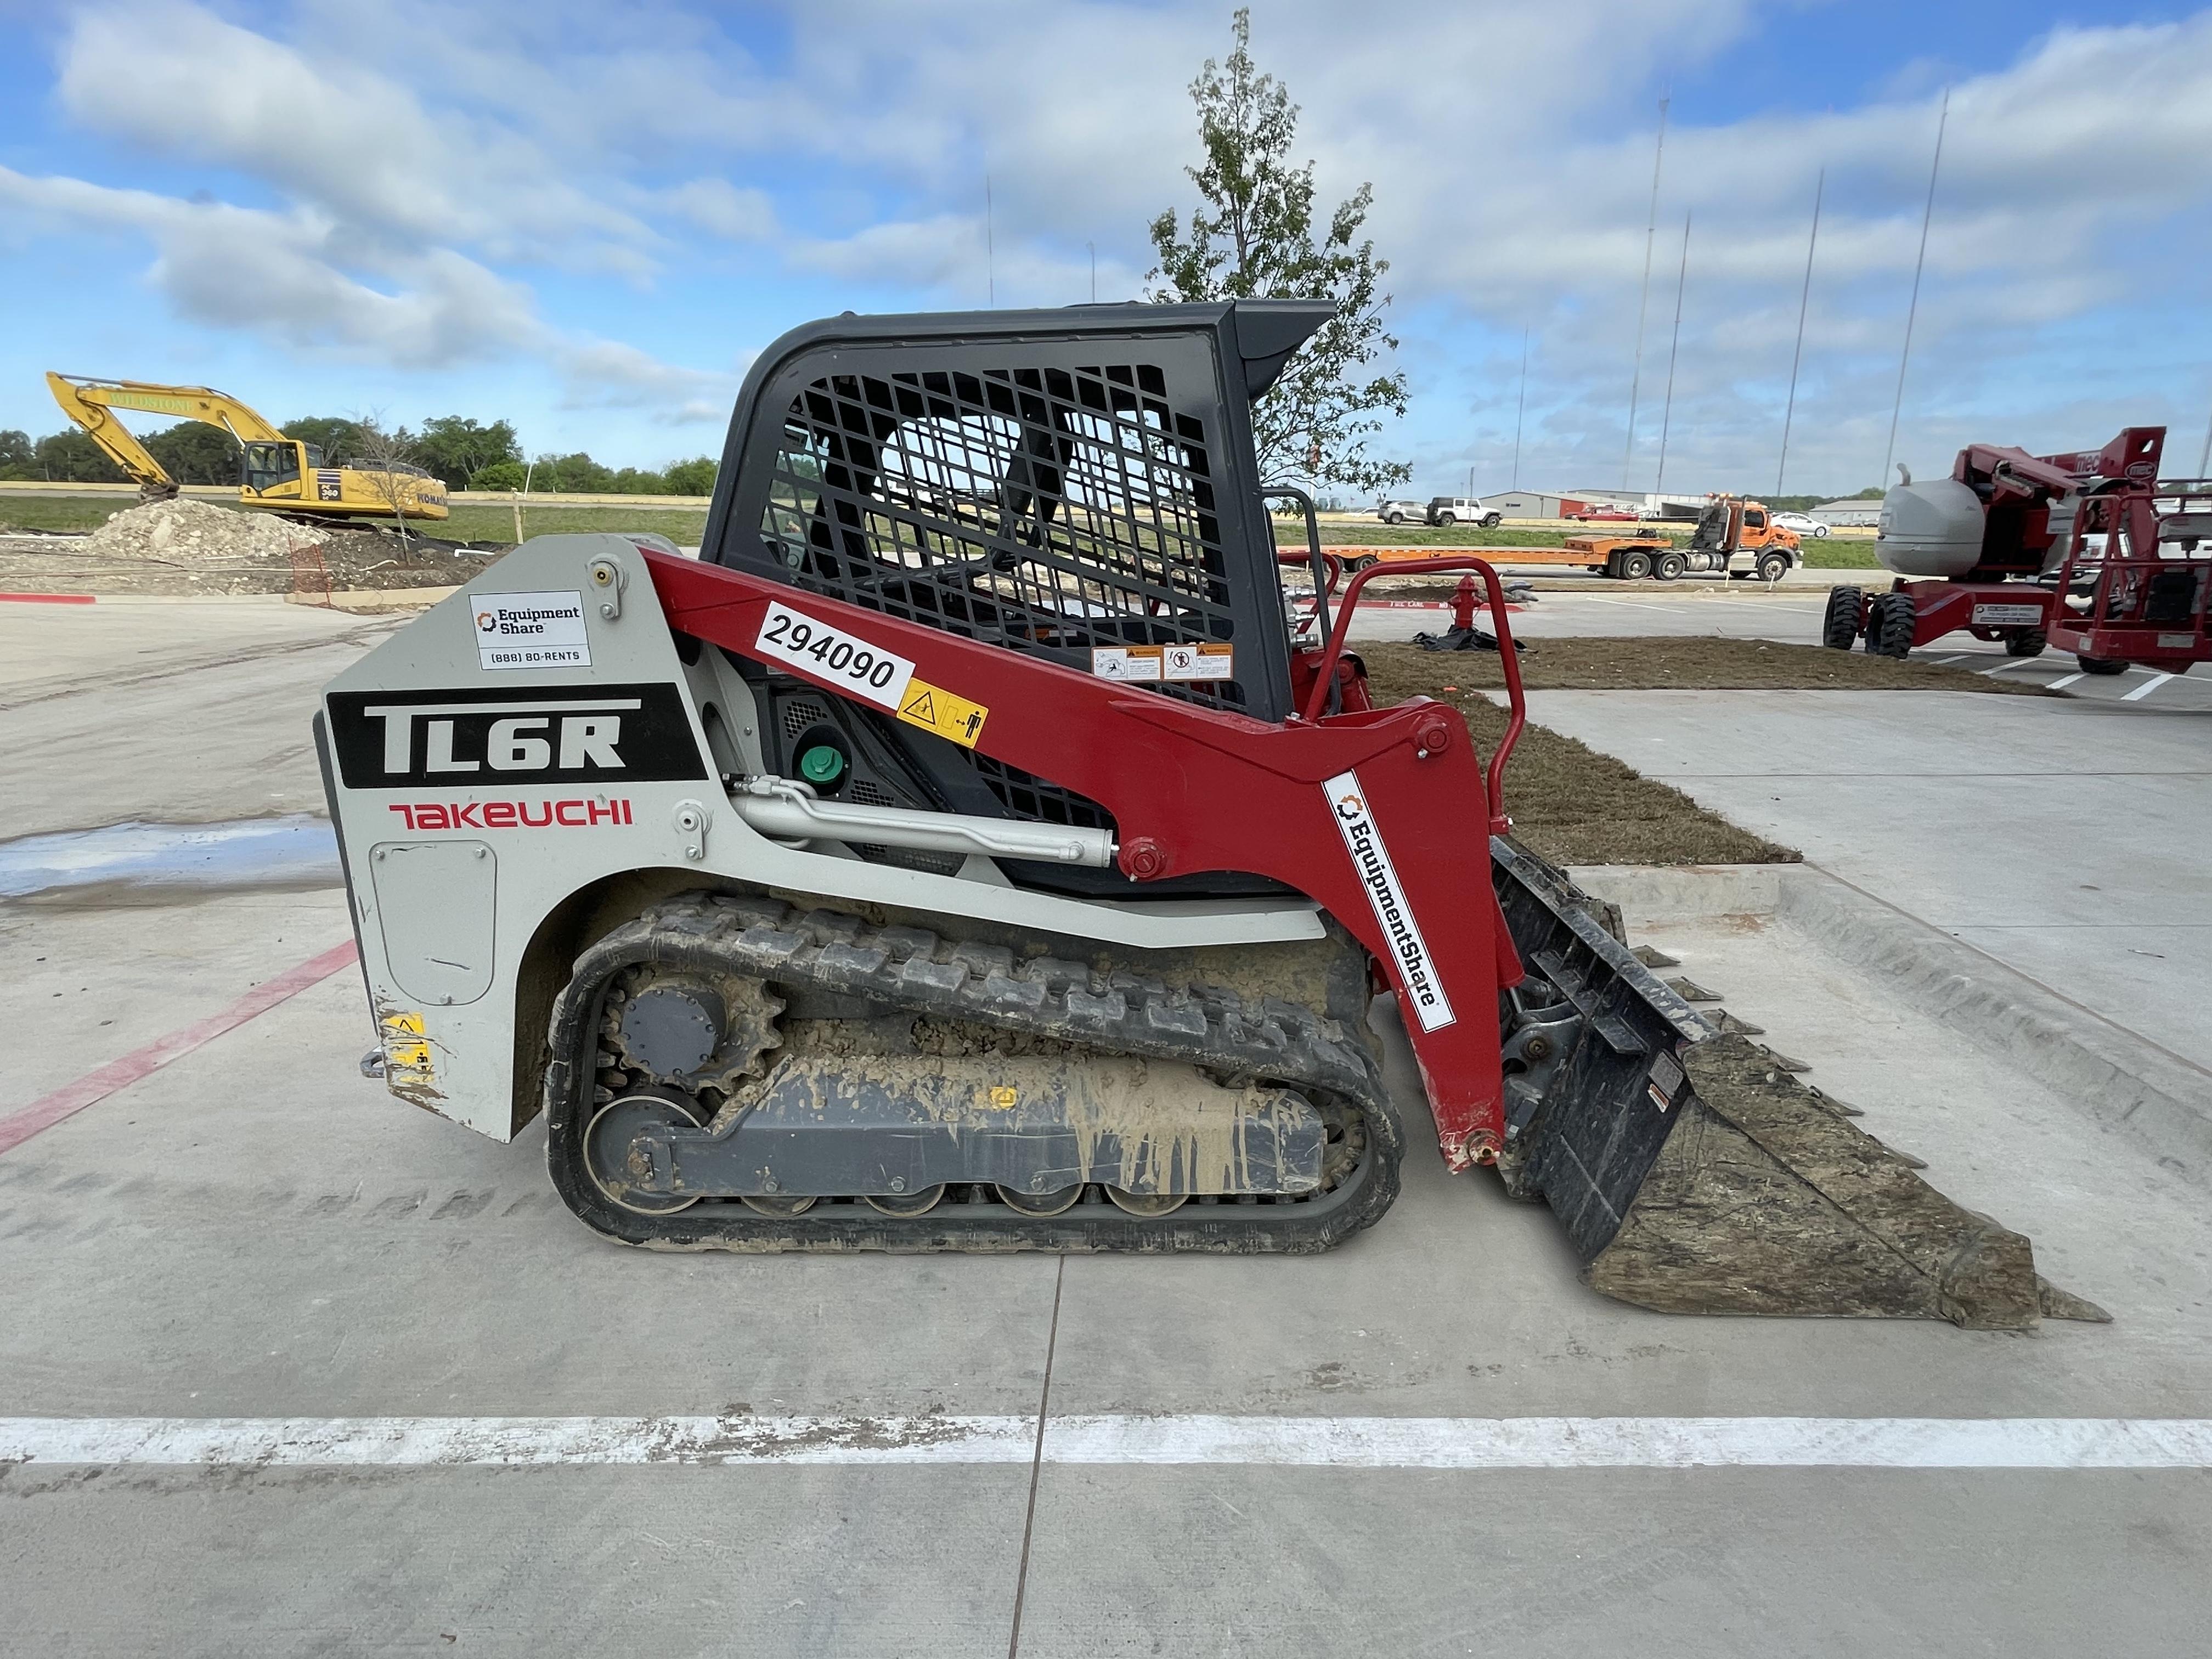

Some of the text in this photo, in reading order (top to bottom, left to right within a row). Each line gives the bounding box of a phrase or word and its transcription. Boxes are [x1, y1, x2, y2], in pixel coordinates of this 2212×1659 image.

[498, 607, 580, 623] Equipment
[500, 623, 544, 634] Share
[492, 653, 522, 663] (888)
[525, 651, 579, 662] 80-RENTS
[764, 614, 894, 688] 294090
[364, 699, 641, 774] TL6R
[1350, 821, 1435, 1006] EquipmentShare
